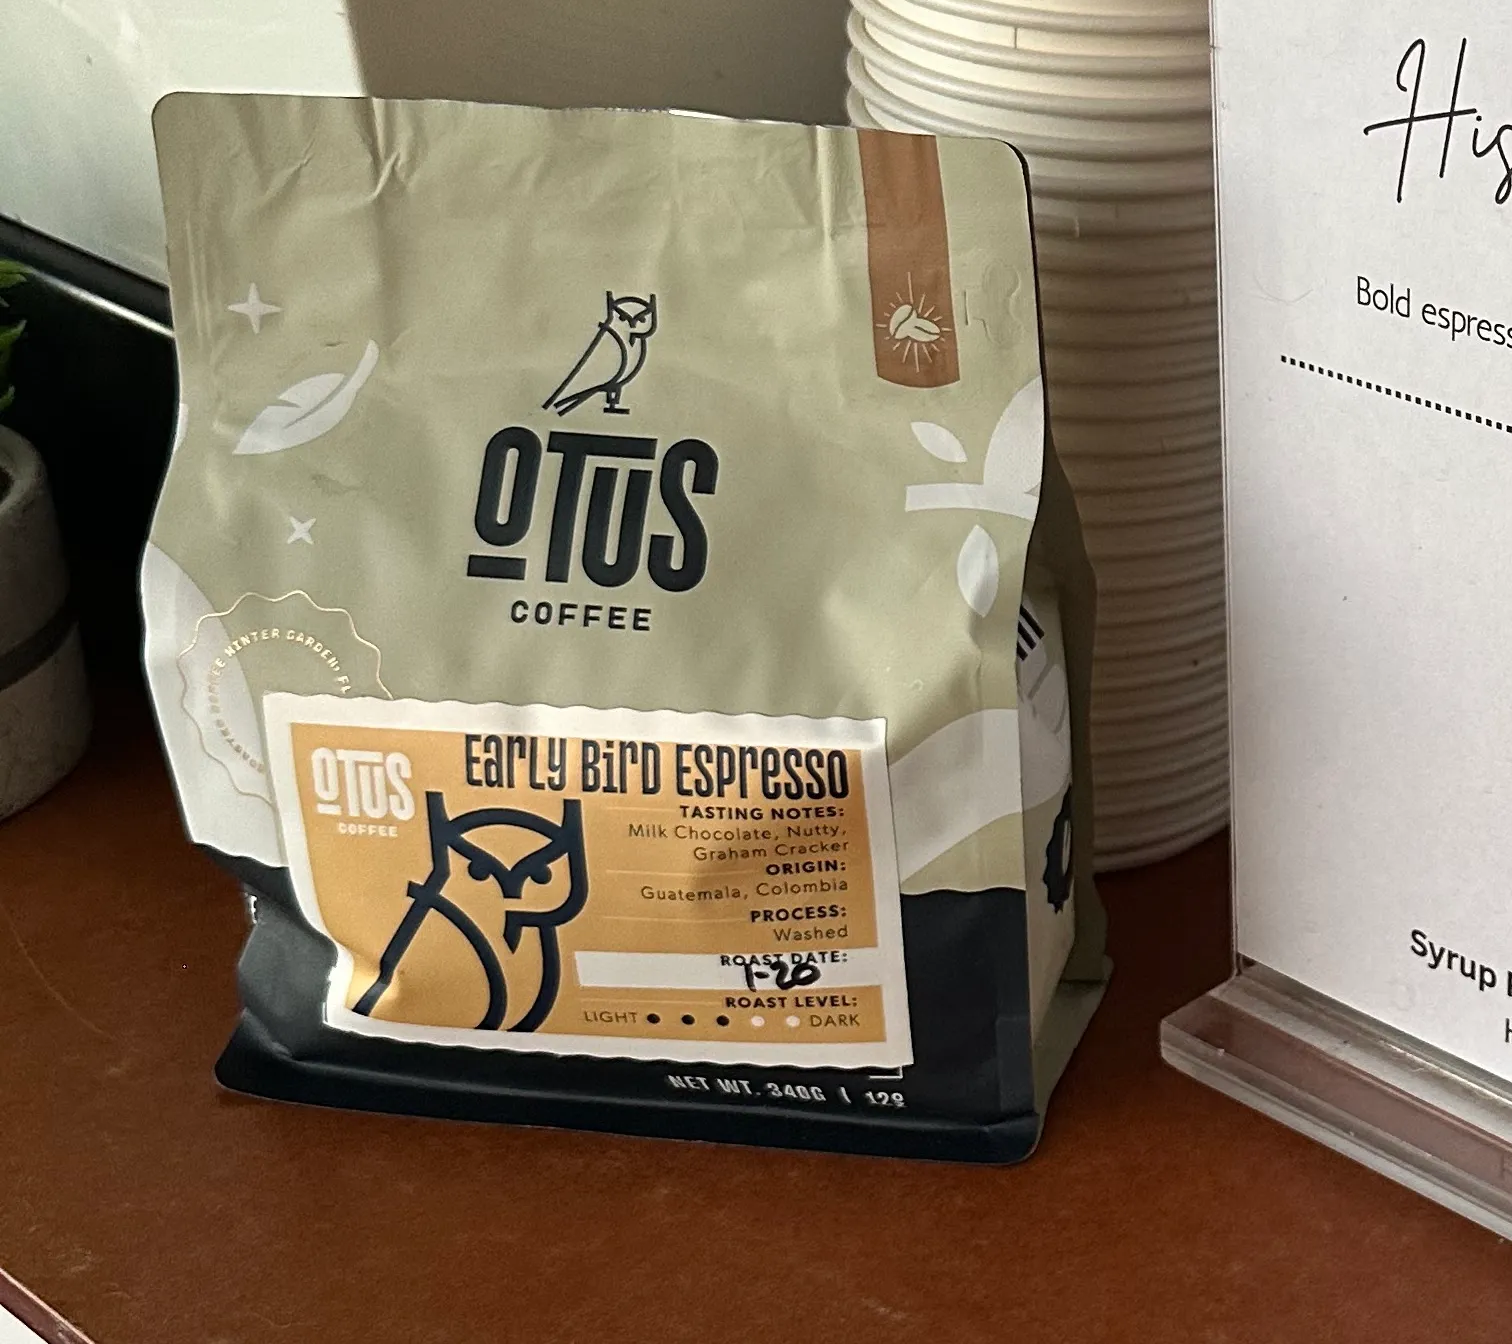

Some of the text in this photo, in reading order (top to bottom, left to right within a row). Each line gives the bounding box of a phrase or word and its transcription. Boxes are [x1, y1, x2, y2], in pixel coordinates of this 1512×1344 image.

[1356, 275, 1411, 318] Bold
[466, 426, 719, 592] OTUS
[510, 600, 652, 631] COFFEE
[224, 628, 280, 657] WINTER
[312, 746, 415, 822] OTUS
[680, 806, 845, 820] TASTING NOTES:
[338, 823, 399, 837] COFFEE
[628, 823, 848, 841] Milk Chocolate, Nutty,
[693, 840, 849, 861] Graham Cracker
[765, 859, 846, 876] ORIGIN:
[641, 877, 848, 901] Guatemala, Colombia
[751, 904, 847, 923] PROCESS:
[773, 924, 849, 942] Washed
[720, 950, 849, 967] ROAST DATE:
[1410, 929, 1497, 992] Syrup
[725, 995, 858, 1009] ROAST LEVEL:
[583, 1010, 861, 1028] LIGHT DARK
[667, 1074, 710, 1092] NET
[716, 1077, 762, 1097] WT.
[766, 1082, 827, 1103] 340G
